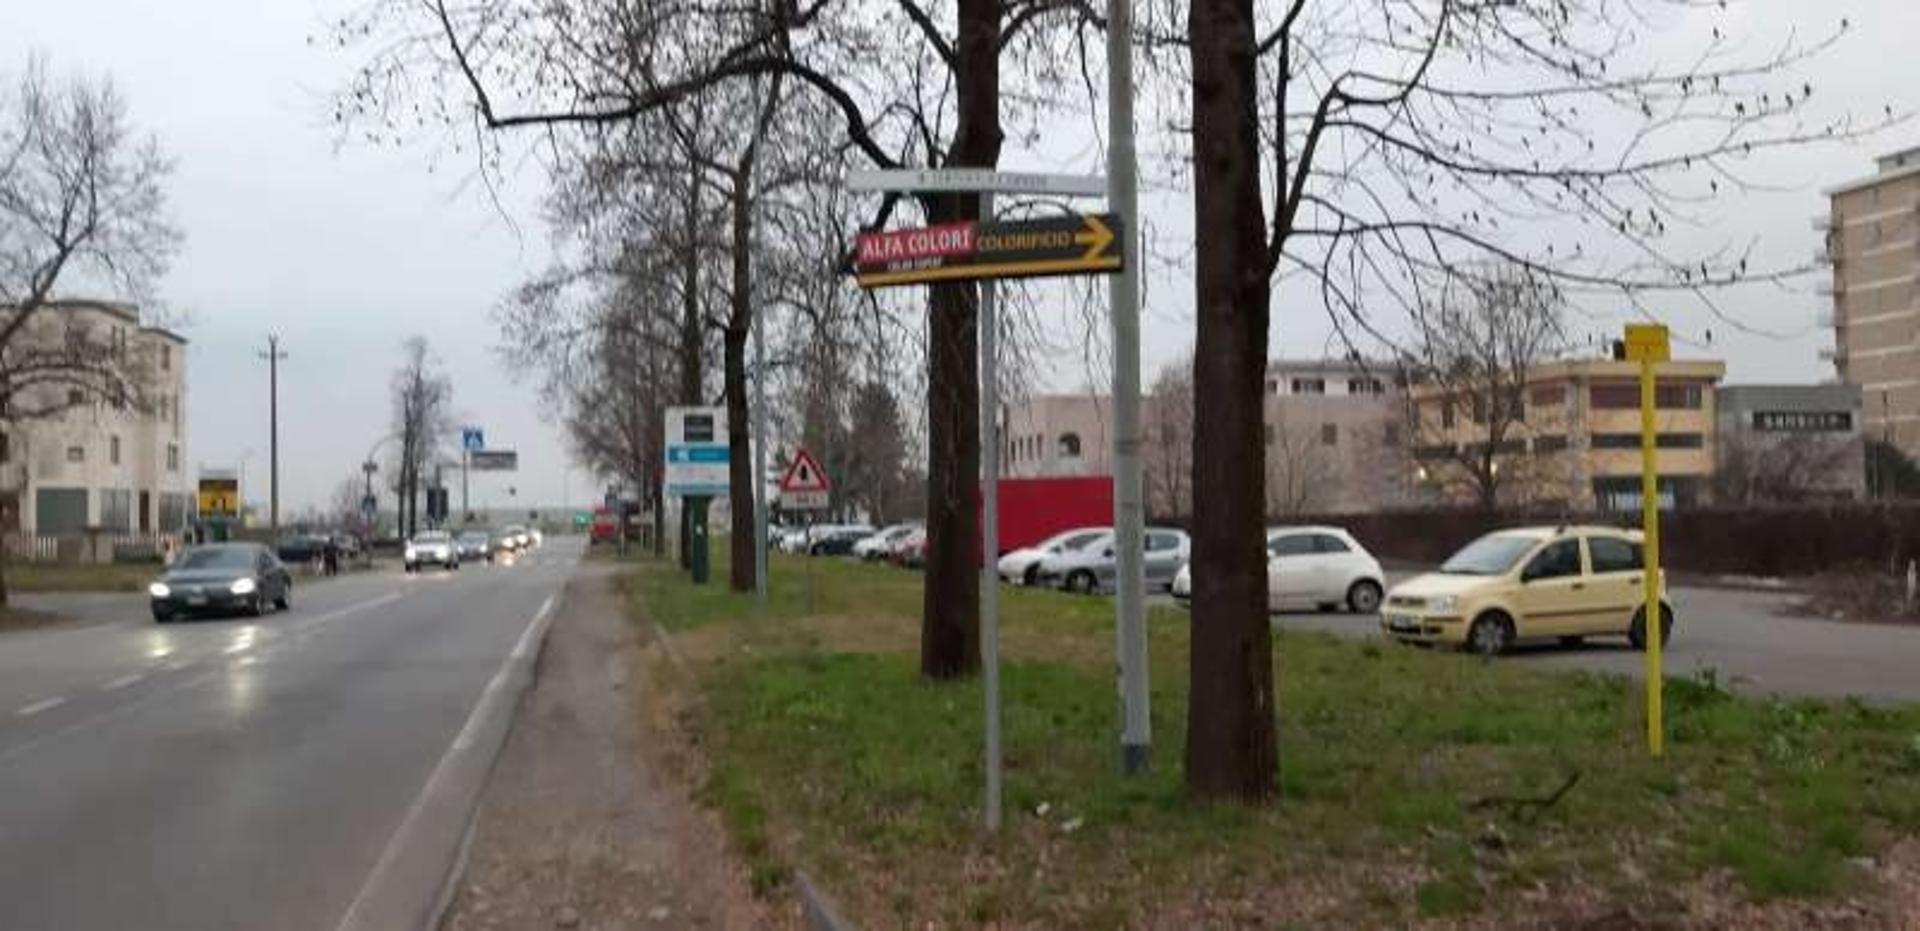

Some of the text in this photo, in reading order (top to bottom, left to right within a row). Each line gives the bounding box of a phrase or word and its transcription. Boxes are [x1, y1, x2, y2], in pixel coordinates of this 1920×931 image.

[861, 229, 1071, 260] ALFA COLORI COLORIFICIO
